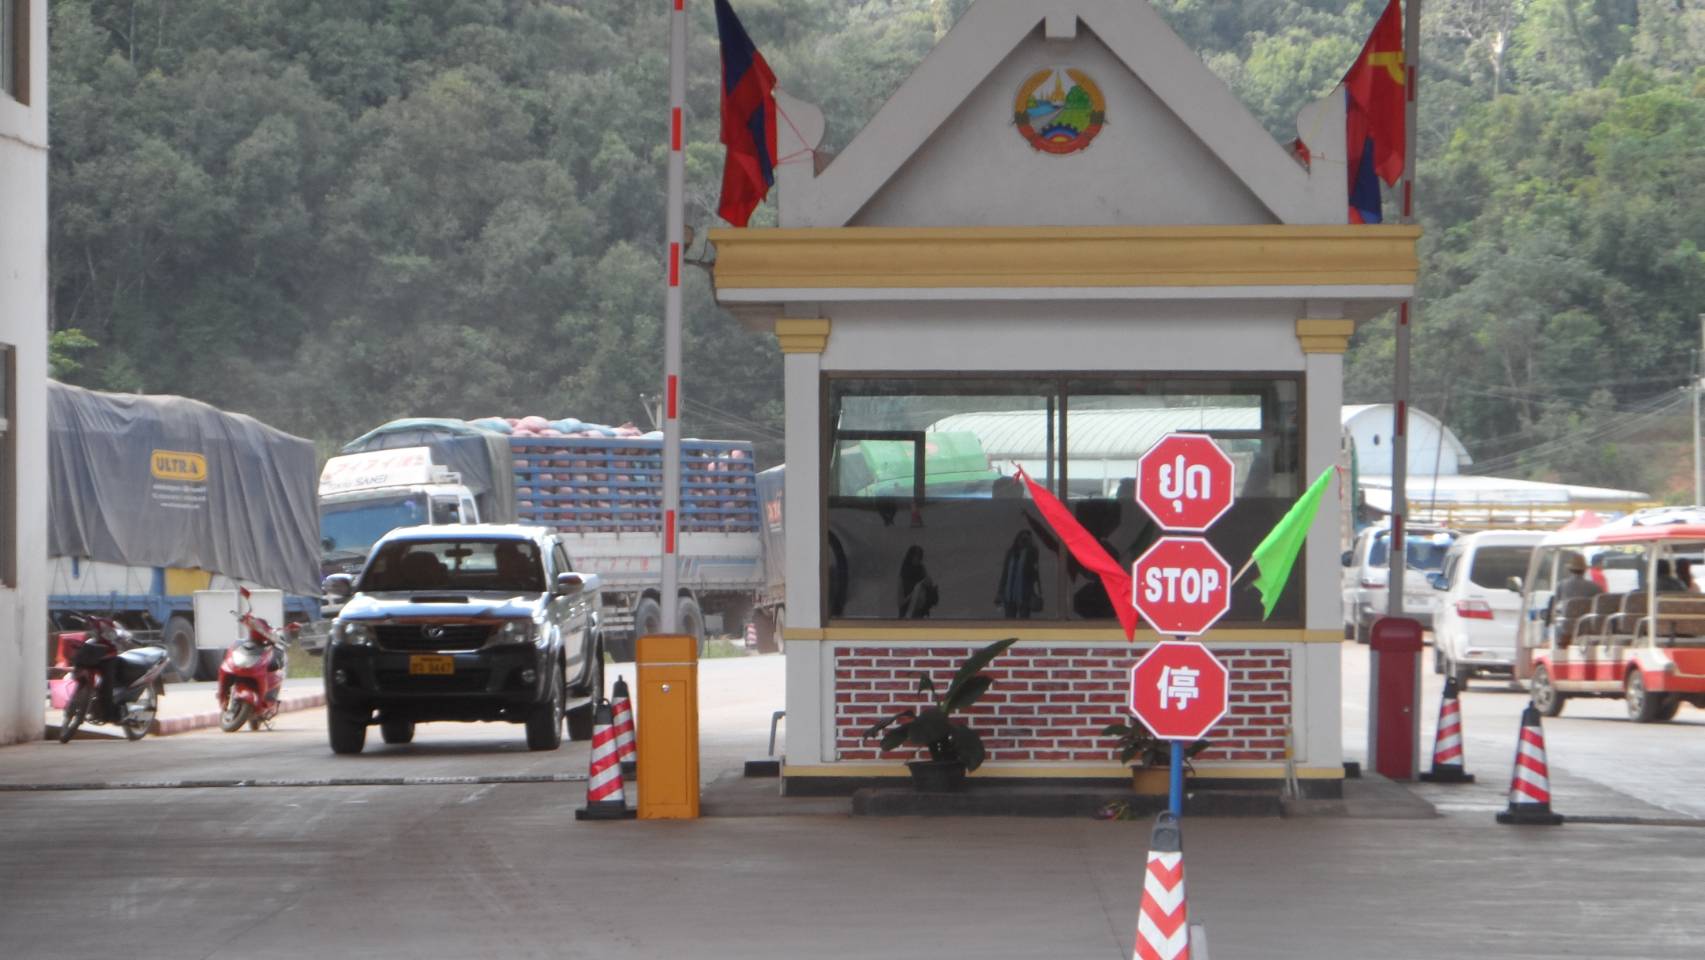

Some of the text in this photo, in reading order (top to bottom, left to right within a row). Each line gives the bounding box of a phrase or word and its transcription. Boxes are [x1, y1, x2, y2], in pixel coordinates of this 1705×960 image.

[156, 456, 198, 473] ULTRA
[1158, 454, 1211, 513] ຢຸດ
[1145, 567, 1219, 604] STOP
[1157, 665, 1200, 711] 停
